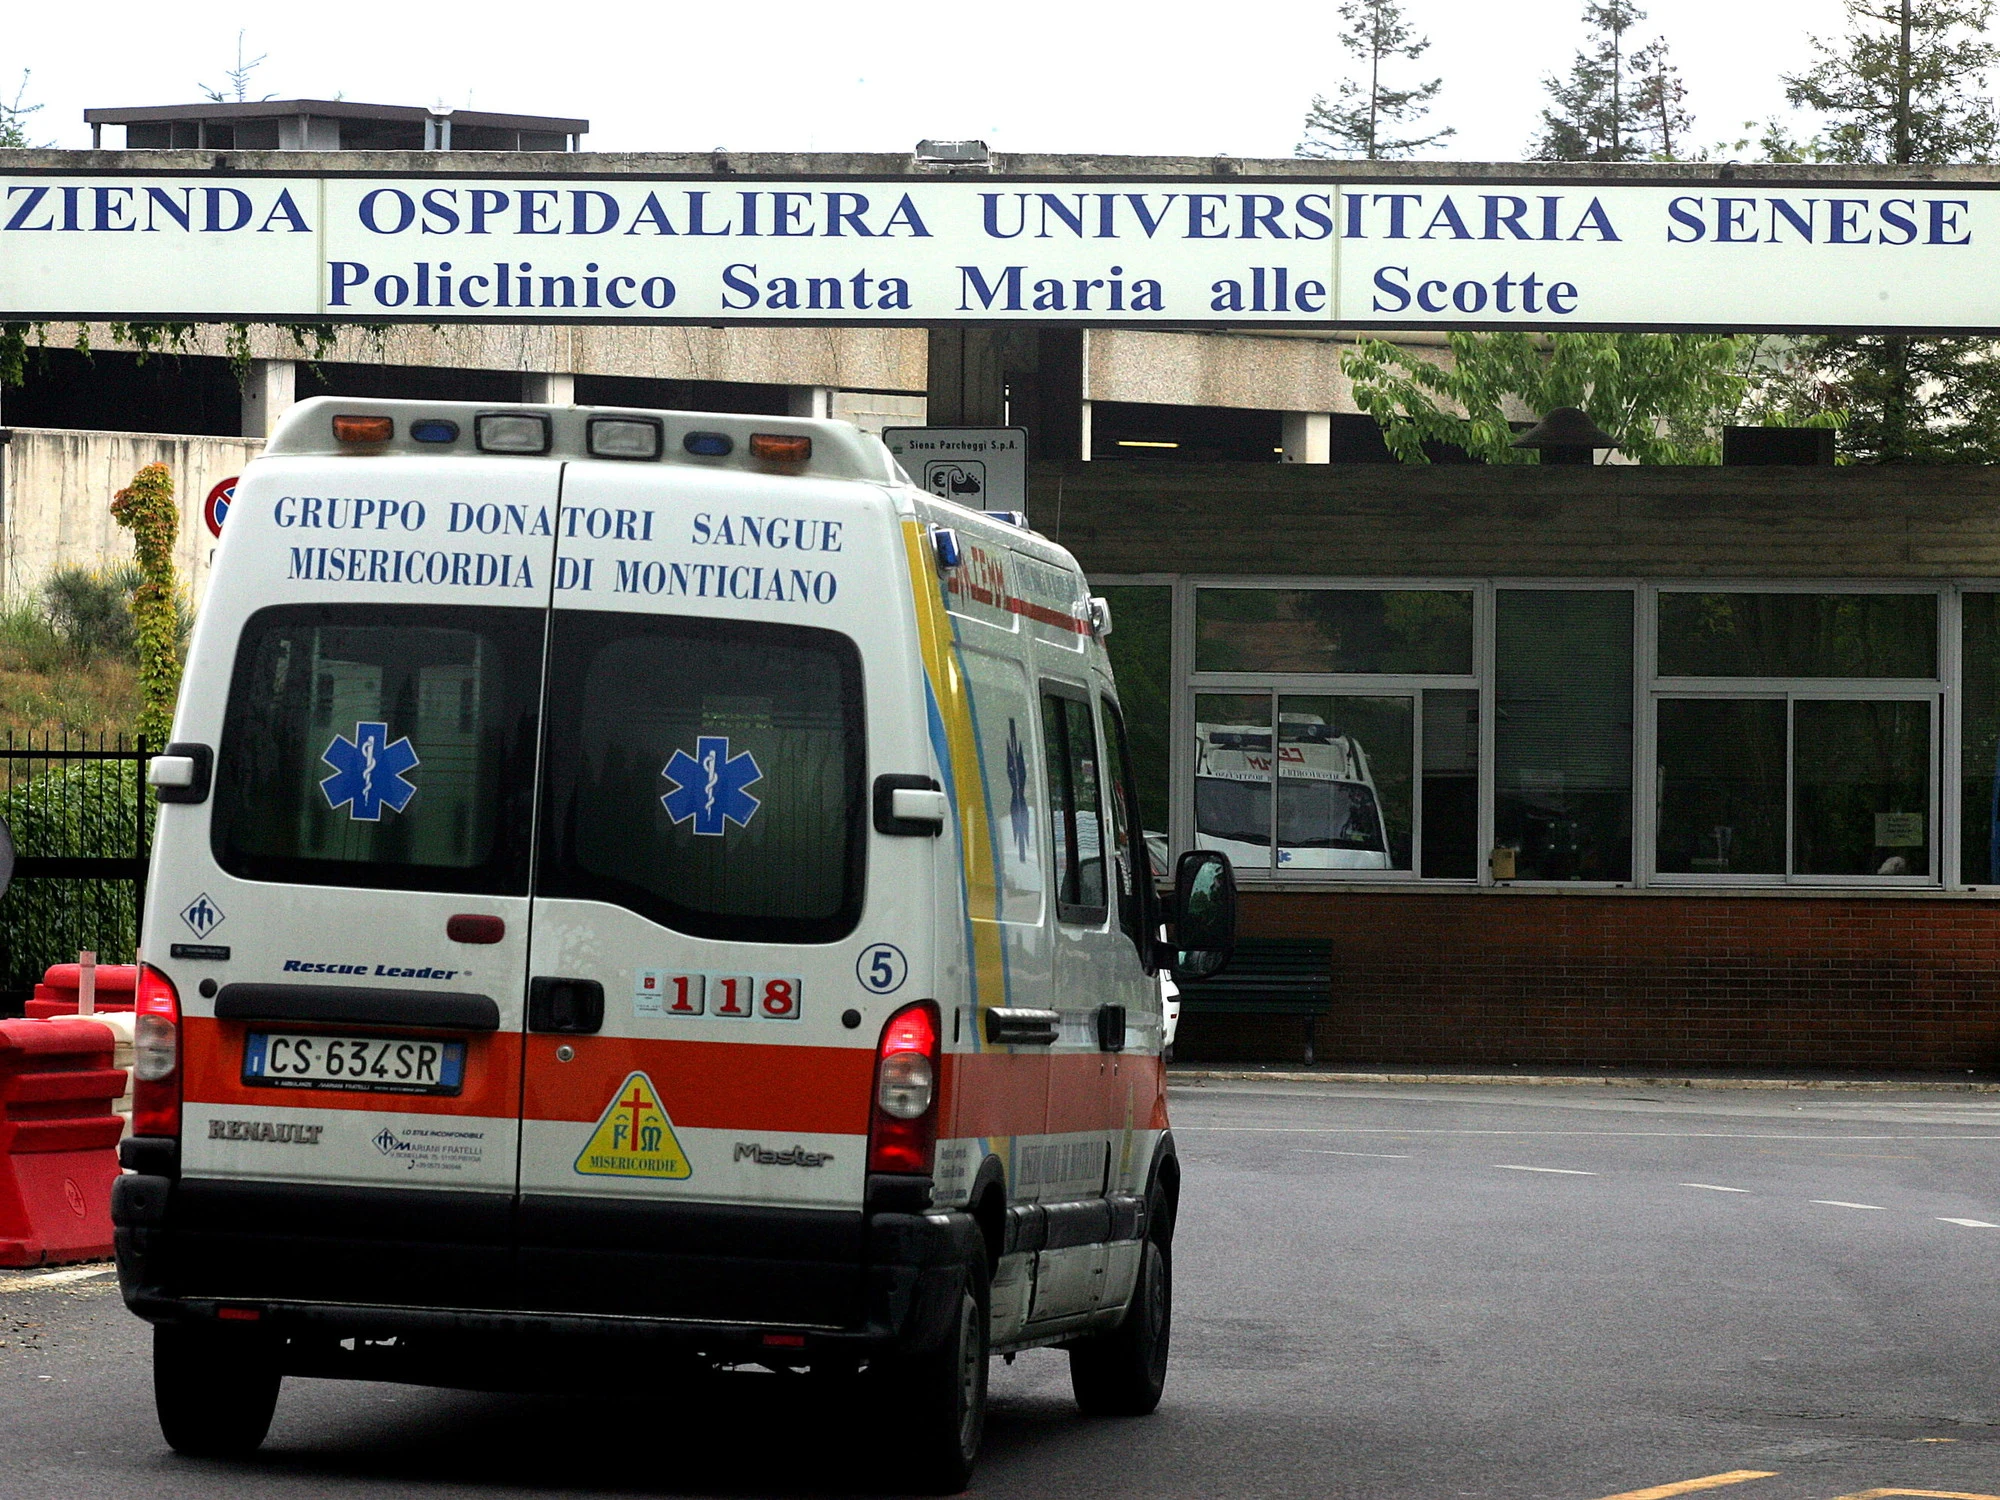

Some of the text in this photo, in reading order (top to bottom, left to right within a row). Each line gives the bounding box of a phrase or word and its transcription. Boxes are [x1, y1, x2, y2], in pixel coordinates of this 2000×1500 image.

[0, 185, 1972, 246] ZIENDA OSPEDALIERA UNIVERSITARIA SENESE
[328, 261, 1579, 315] Policlinico Santa Maria alle Scotte
[909, 440, 1018, 453] Siena Parcheggi S.p.A.
[275, 497, 844, 554] GRUPPO DONATORI SANGUE
[288, 547, 839, 607] MISERICORDIA DI MONTICIANO
[283, 960, 458, 980] Rescue Leader
[870, 951, 892, 988] 5
[208, 1119, 323, 1145] RENAULT
[394, 1142, 482, 1155] MARIANI FRATELLI
[734, 1142, 835, 1168] Master
[590, 1155, 678, 1173] MISERICORDIE
